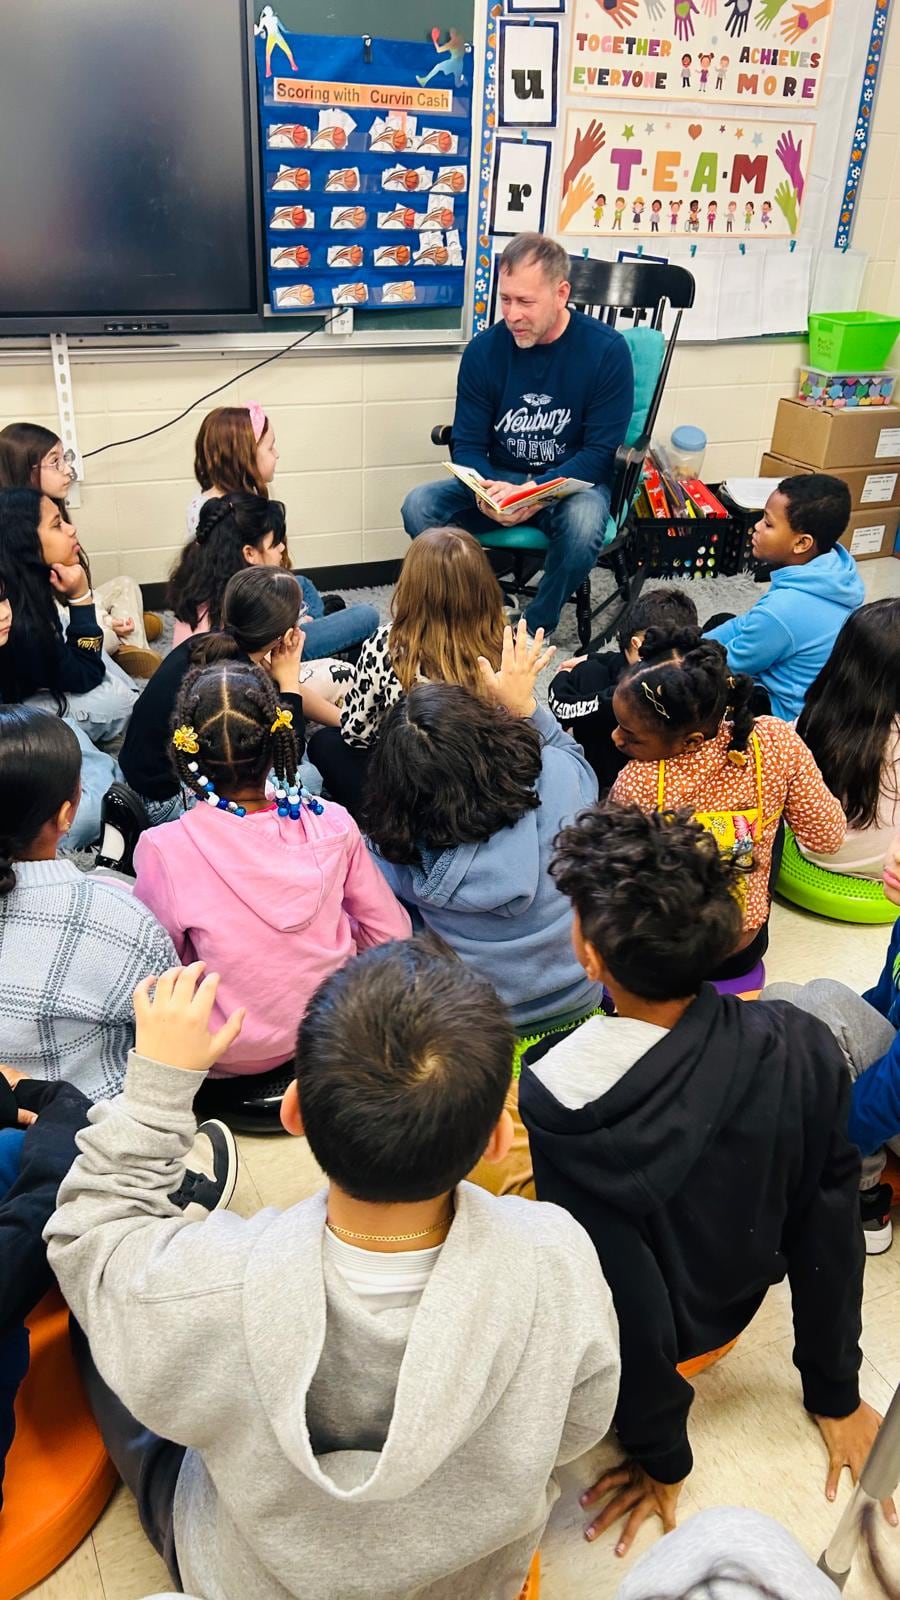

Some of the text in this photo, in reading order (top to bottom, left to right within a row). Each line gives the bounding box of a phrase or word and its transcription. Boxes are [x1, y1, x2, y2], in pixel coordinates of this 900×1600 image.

[576, 33, 672, 57] TOGETHER
[739, 46, 821, 69] ACHIEVES
[511, 69, 544, 100] u
[573, 66, 667, 89] EVERYONE
[737, 73, 816, 98] MORE
[277, 82, 449, 108] Scoring with Curvin Cash
[507, 183, 532, 212] r
[494, 406, 572, 436] Newbury
[506, 438, 556, 462] CREW
